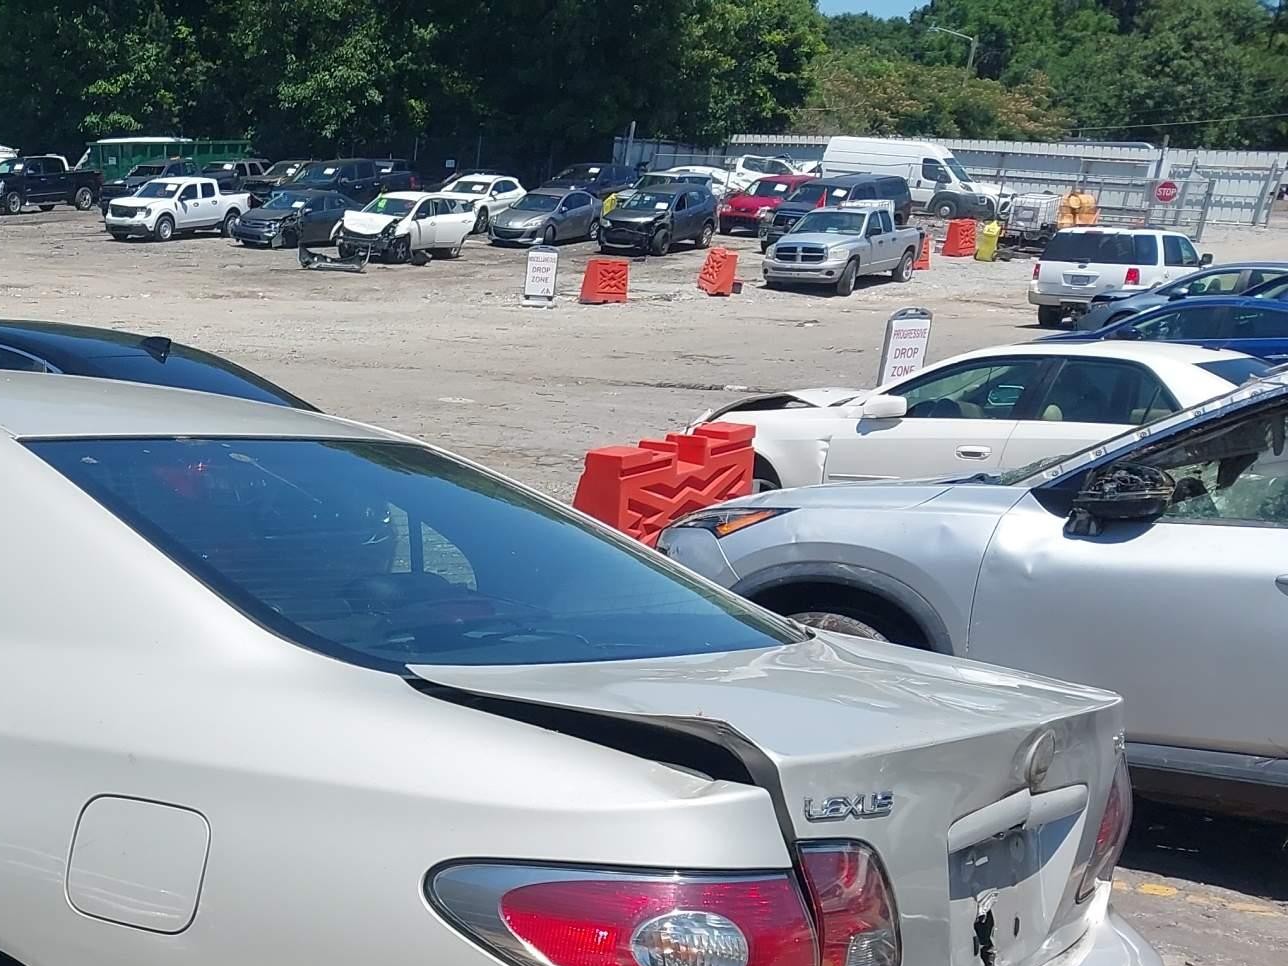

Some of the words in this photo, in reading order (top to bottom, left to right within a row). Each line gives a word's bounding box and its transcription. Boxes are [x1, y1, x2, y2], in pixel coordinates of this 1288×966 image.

[1157, 187, 1177, 197] STOP
[893, 328, 928, 340] PROGRESSIVE
[894, 347, 919, 359] DROP
[804, 790, 894, 824] LEXUS
